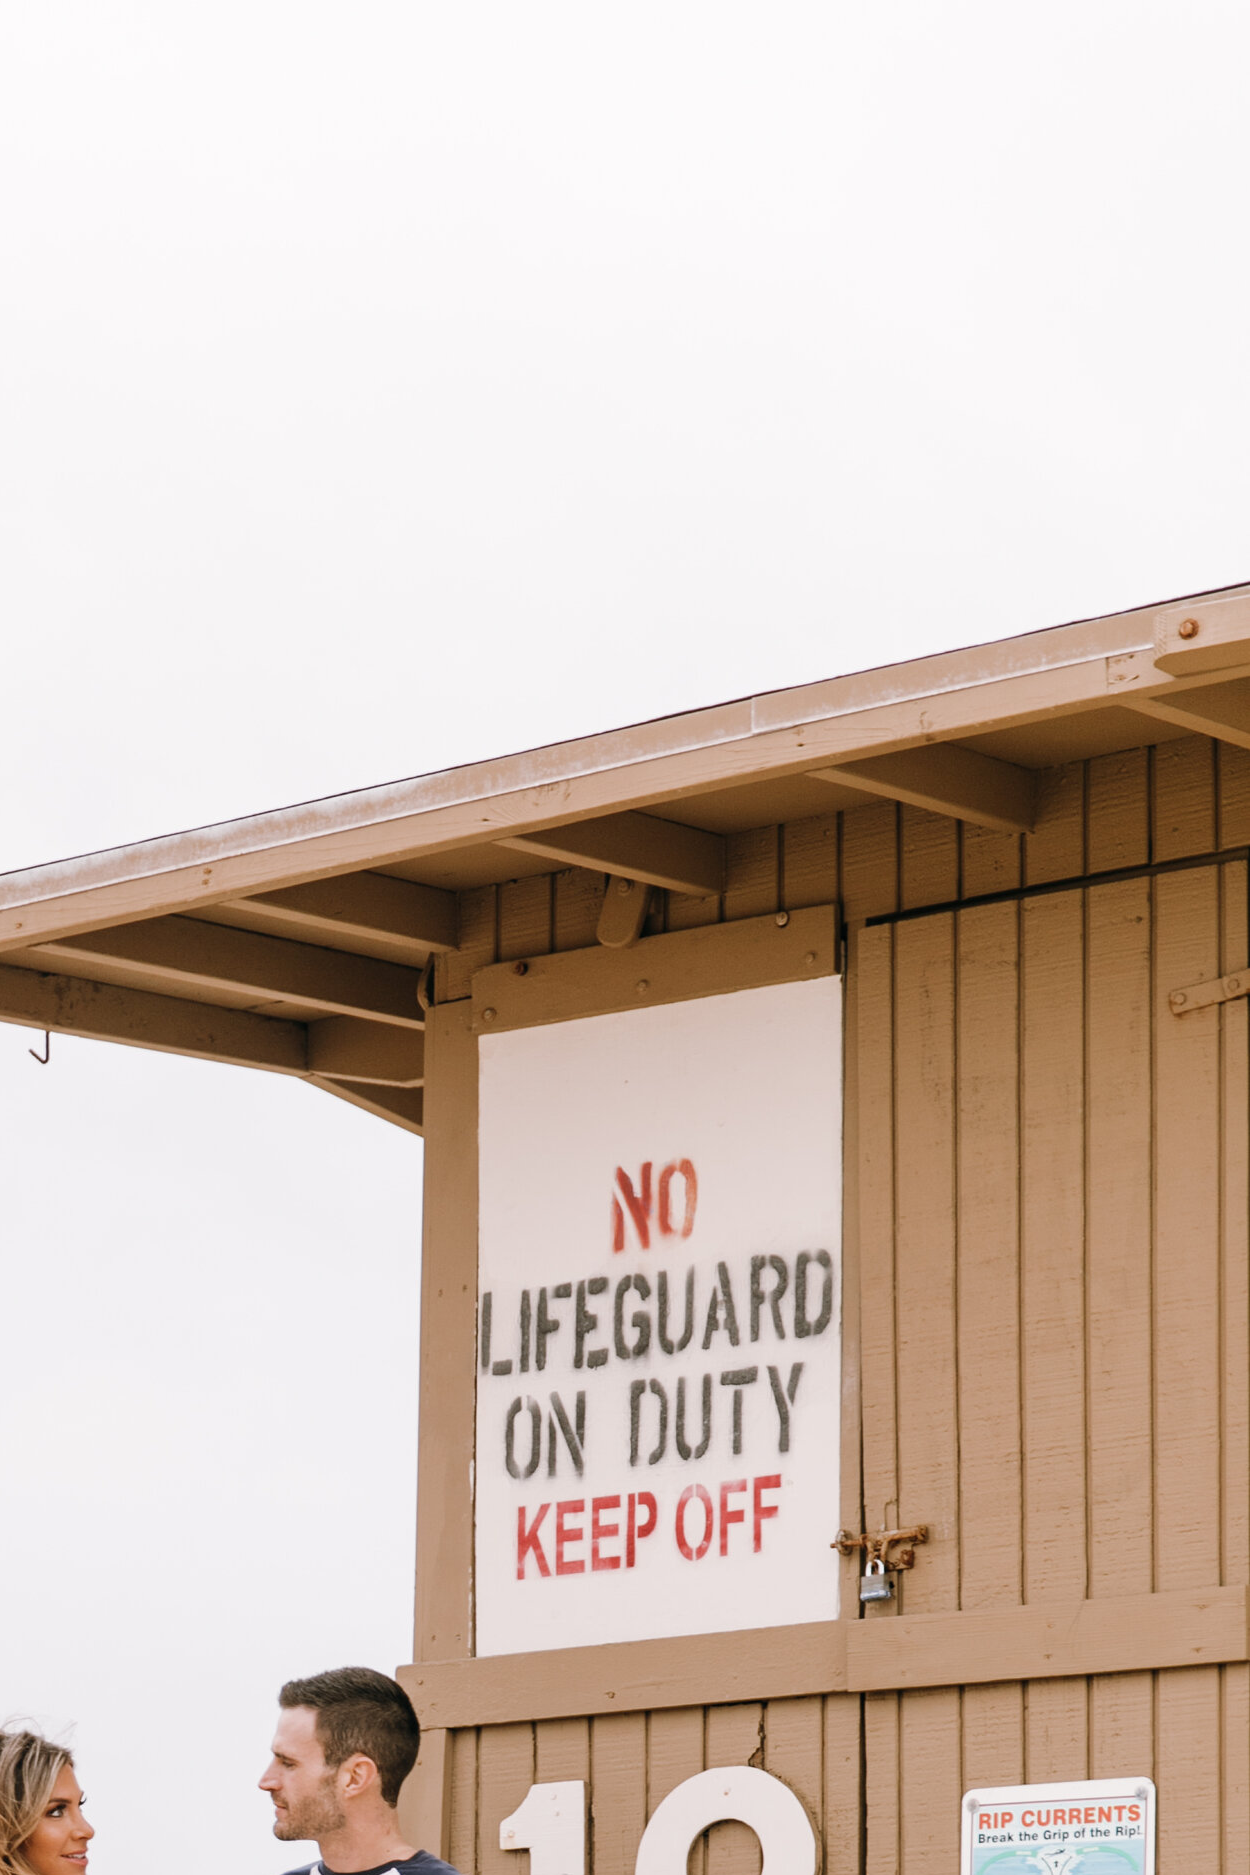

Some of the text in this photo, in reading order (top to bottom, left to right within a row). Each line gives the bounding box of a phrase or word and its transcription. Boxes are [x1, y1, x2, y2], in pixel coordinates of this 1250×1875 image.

[611, 1158, 698, 1253] NO
[480, 1249, 833, 1376] LIFEGUARD
[505, 1362, 805, 1481] ON DUTY
[516, 1473, 782, 1580] KEEP OFF
[978, 1804, 1141, 1830] RIP CURRENTS
[978, 1825, 1141, 1844] Break the Grip of the Rip!
